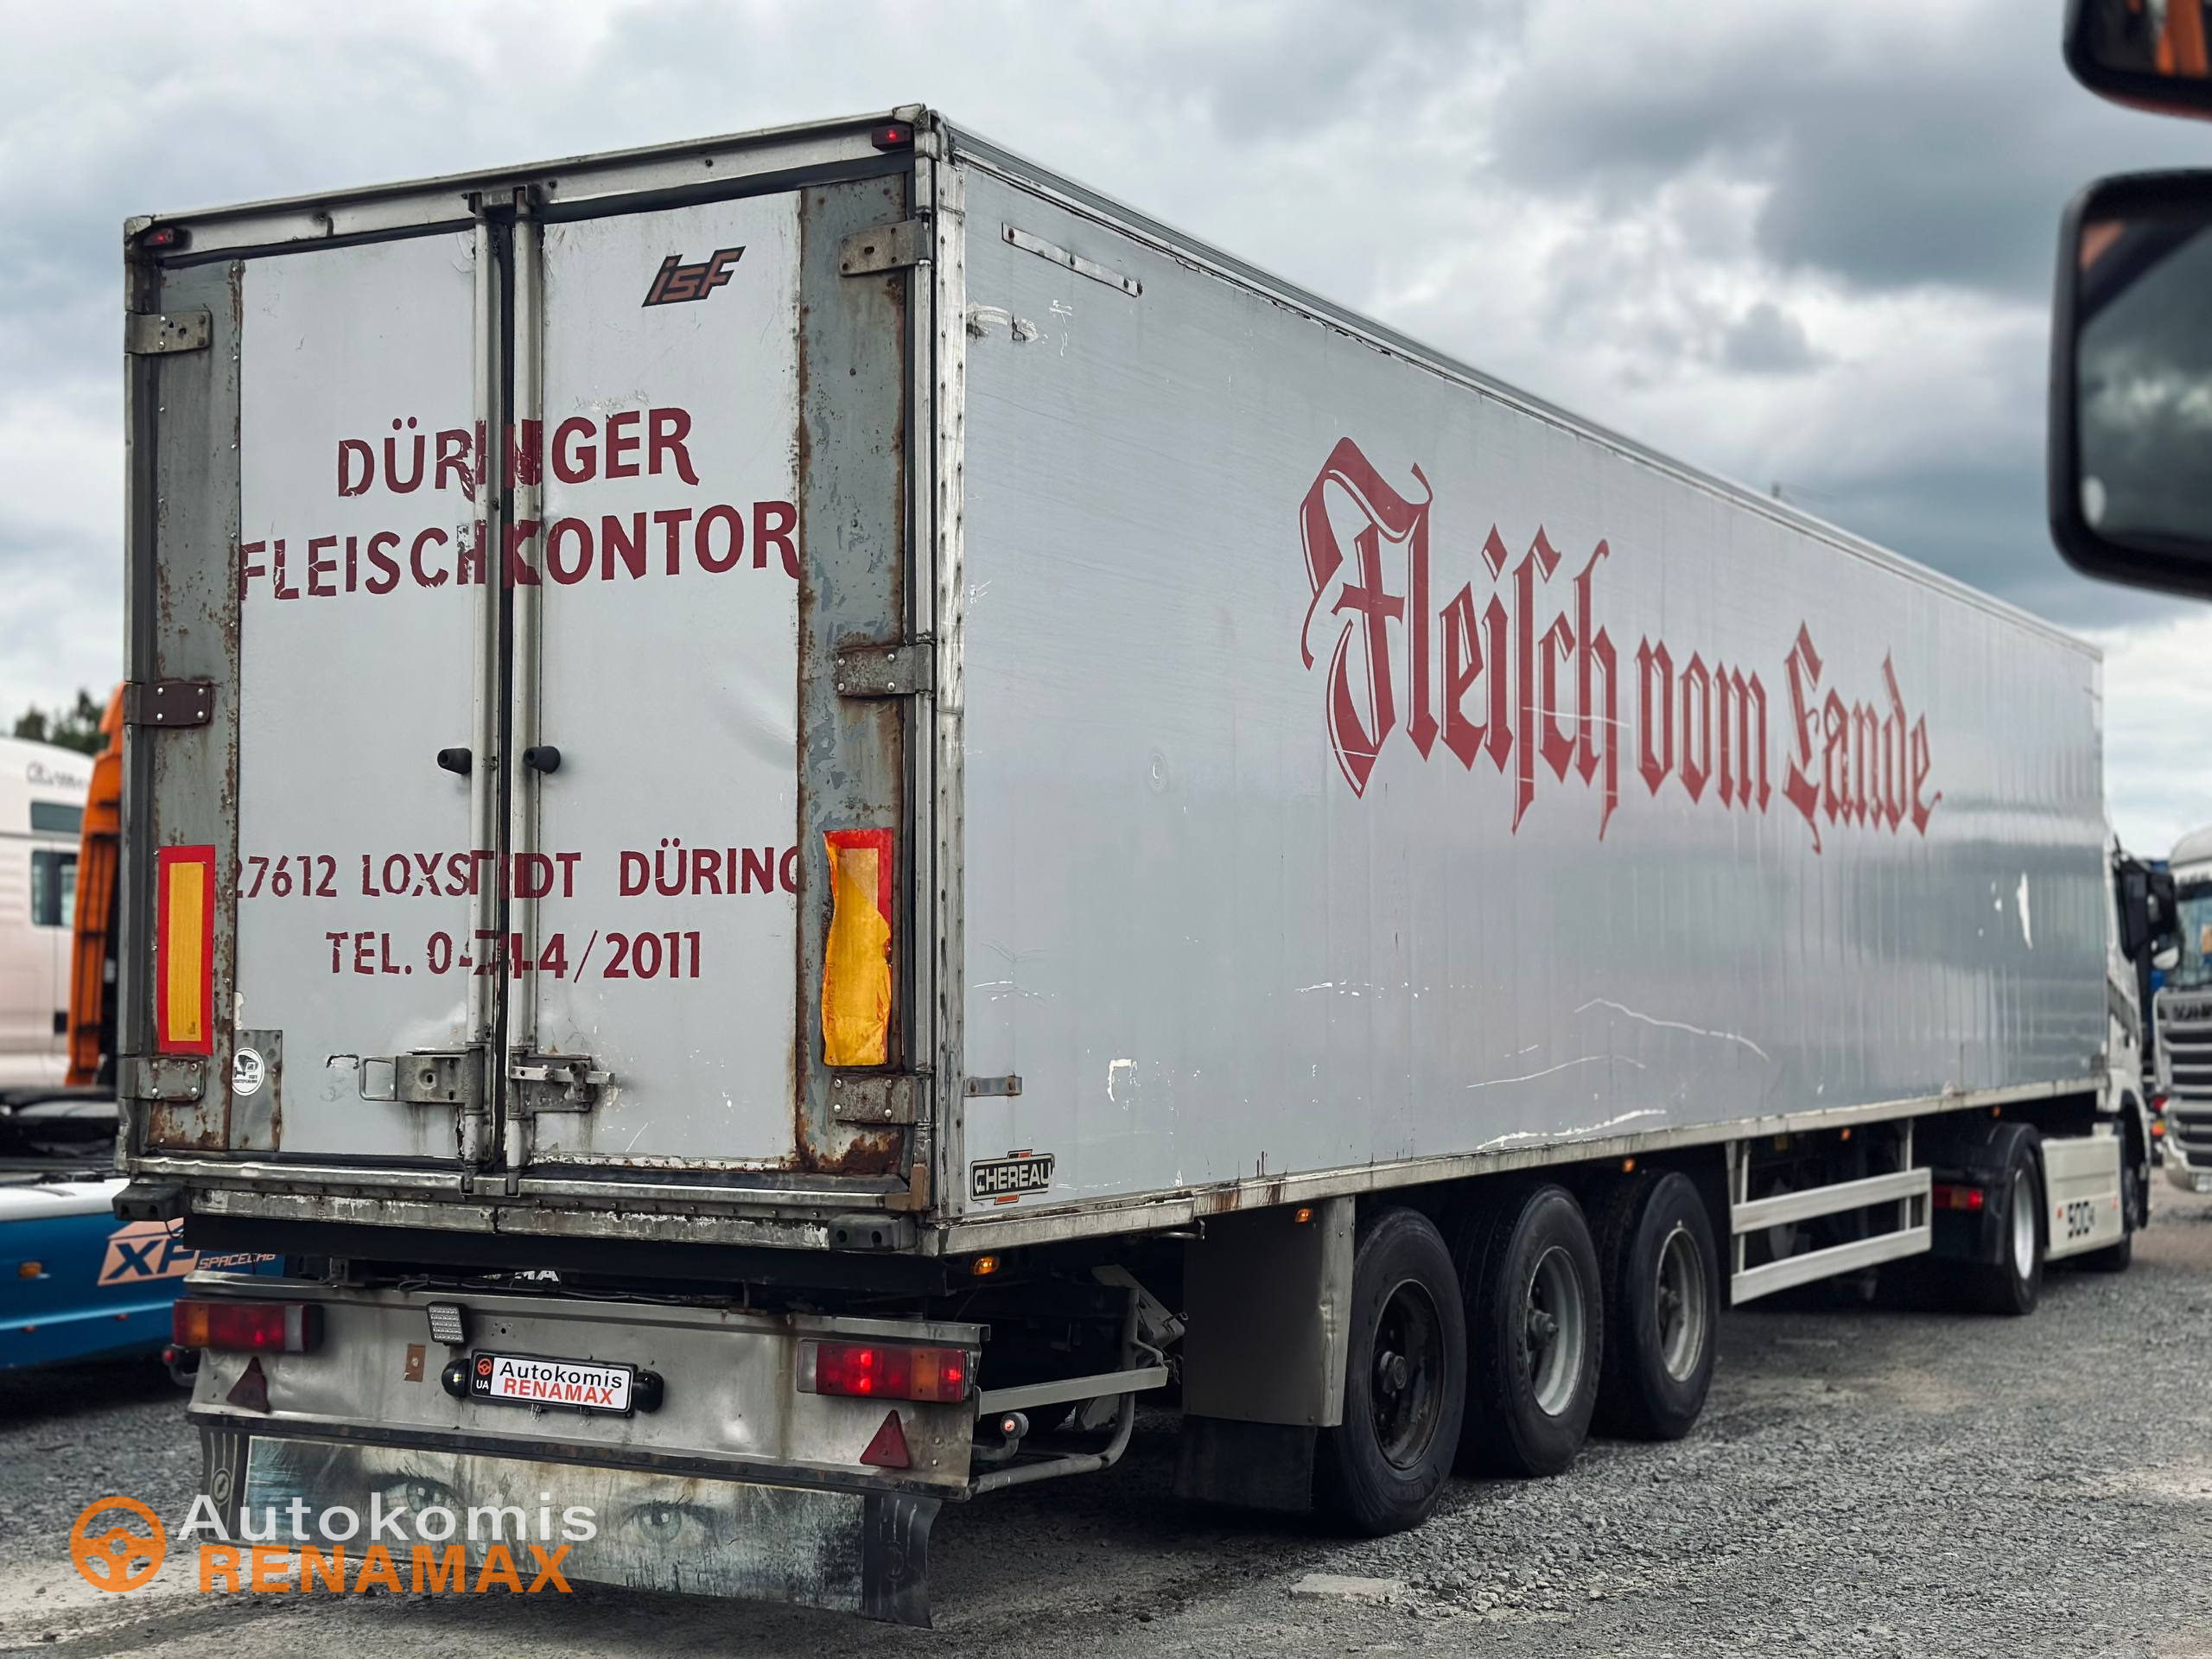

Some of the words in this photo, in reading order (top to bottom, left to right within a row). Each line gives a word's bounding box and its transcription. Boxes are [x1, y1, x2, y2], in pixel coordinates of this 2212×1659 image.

[338, 407, 699, 504] DÜRINGER
[239, 500, 800, 601] FLEISCHKONTOR
[1636, 634, 1771, 814] vom
[325, 931, 412, 976] TEL.
[974, 1161, 1052, 1193] CHEREAU
[476, 1379, 489, 1390] UA
[499, 1361, 622, 1389] Autokomis
[503, 1377, 614, 1406] RENAMAX
